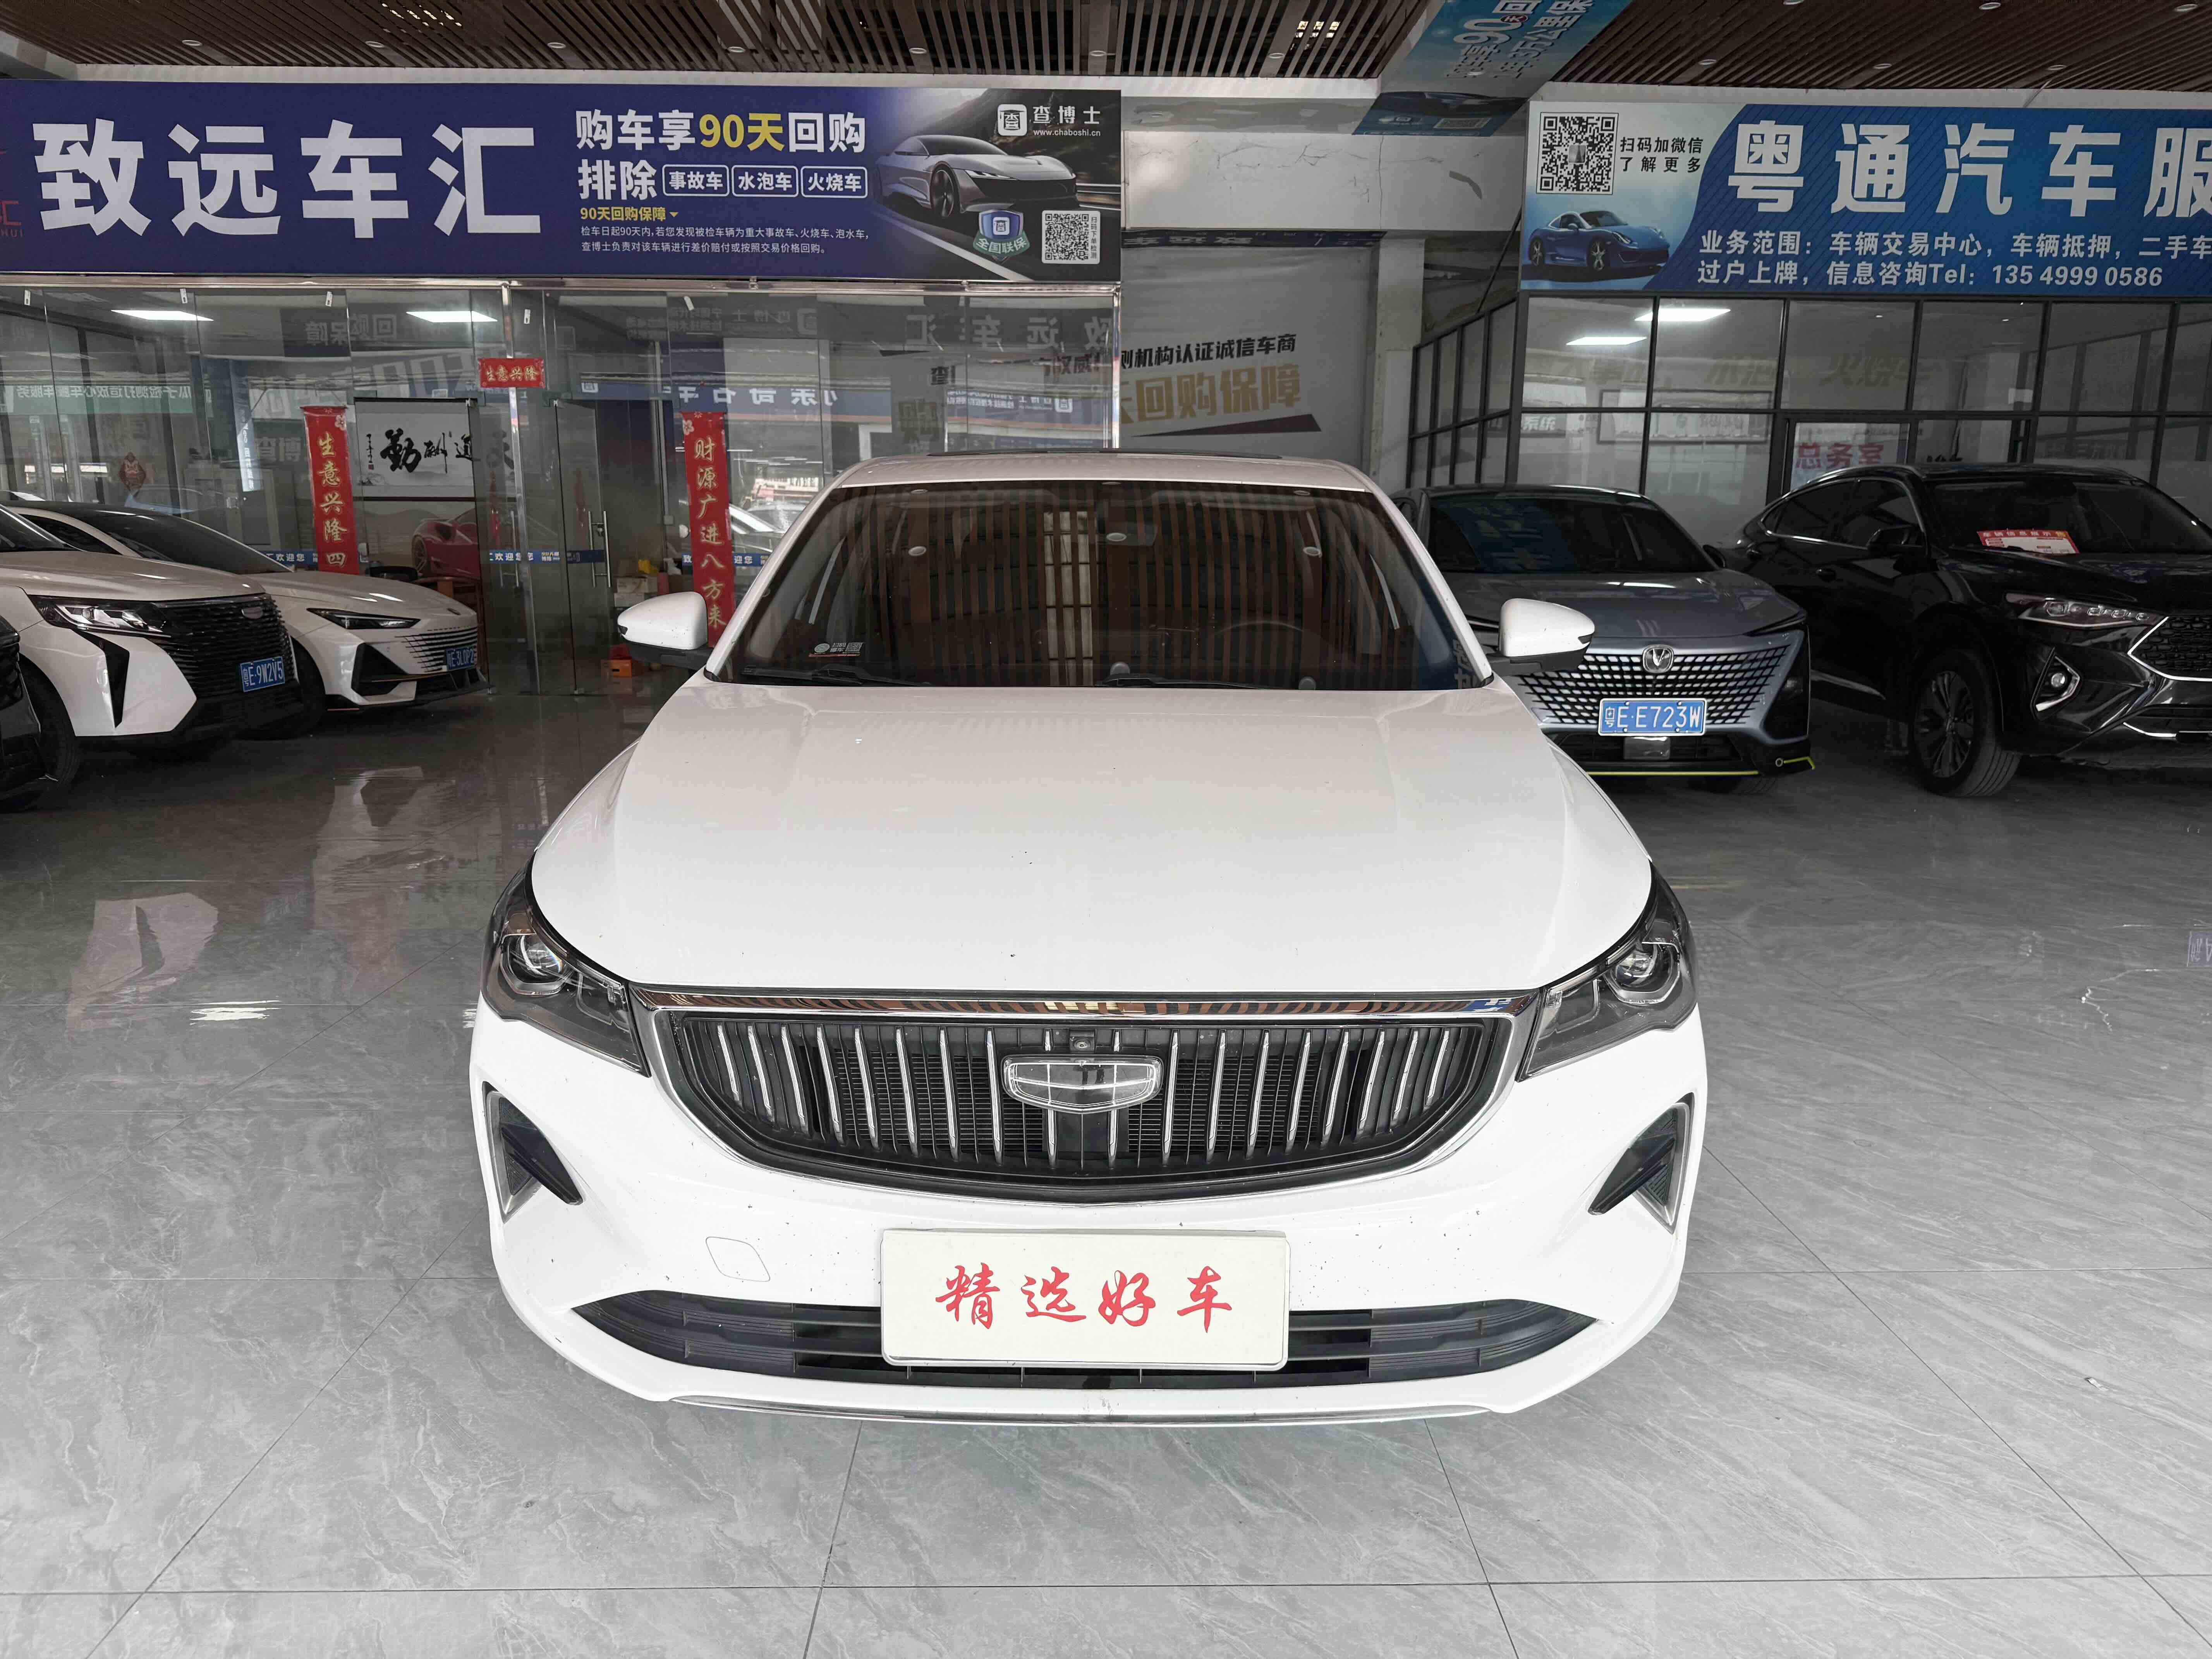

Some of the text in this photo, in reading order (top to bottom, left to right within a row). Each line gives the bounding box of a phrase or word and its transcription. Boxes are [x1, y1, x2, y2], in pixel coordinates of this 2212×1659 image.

[1033, 106, 1100, 124] 查博士
[575, 108, 866, 153] 购车享90天回购
[1620, 137, 1704, 154] 扫码加微信
[1620, 156, 1701, 173] 了解更多
[1728, 120, 2212, 217] 粤通汽车服
[32, 118, 541, 239] 致远车汇
[577, 159, 862, 201] 排除 事故车 水泡车 火烧车
[580, 206, 666, 222] 90天回购保障
[975, 237, 1027, 254] 全国联保
[2040, 266, 2098, 286] 4999
[2105, 266, 2163, 287] 0586
[486, 365, 539, 381] 生意兴隆
[266, 553, 305, 562] 欢迎您
[1604, 706, 1701, 729] 粤E·E723W
[935, 1262, 1232, 1333] 精选好车
